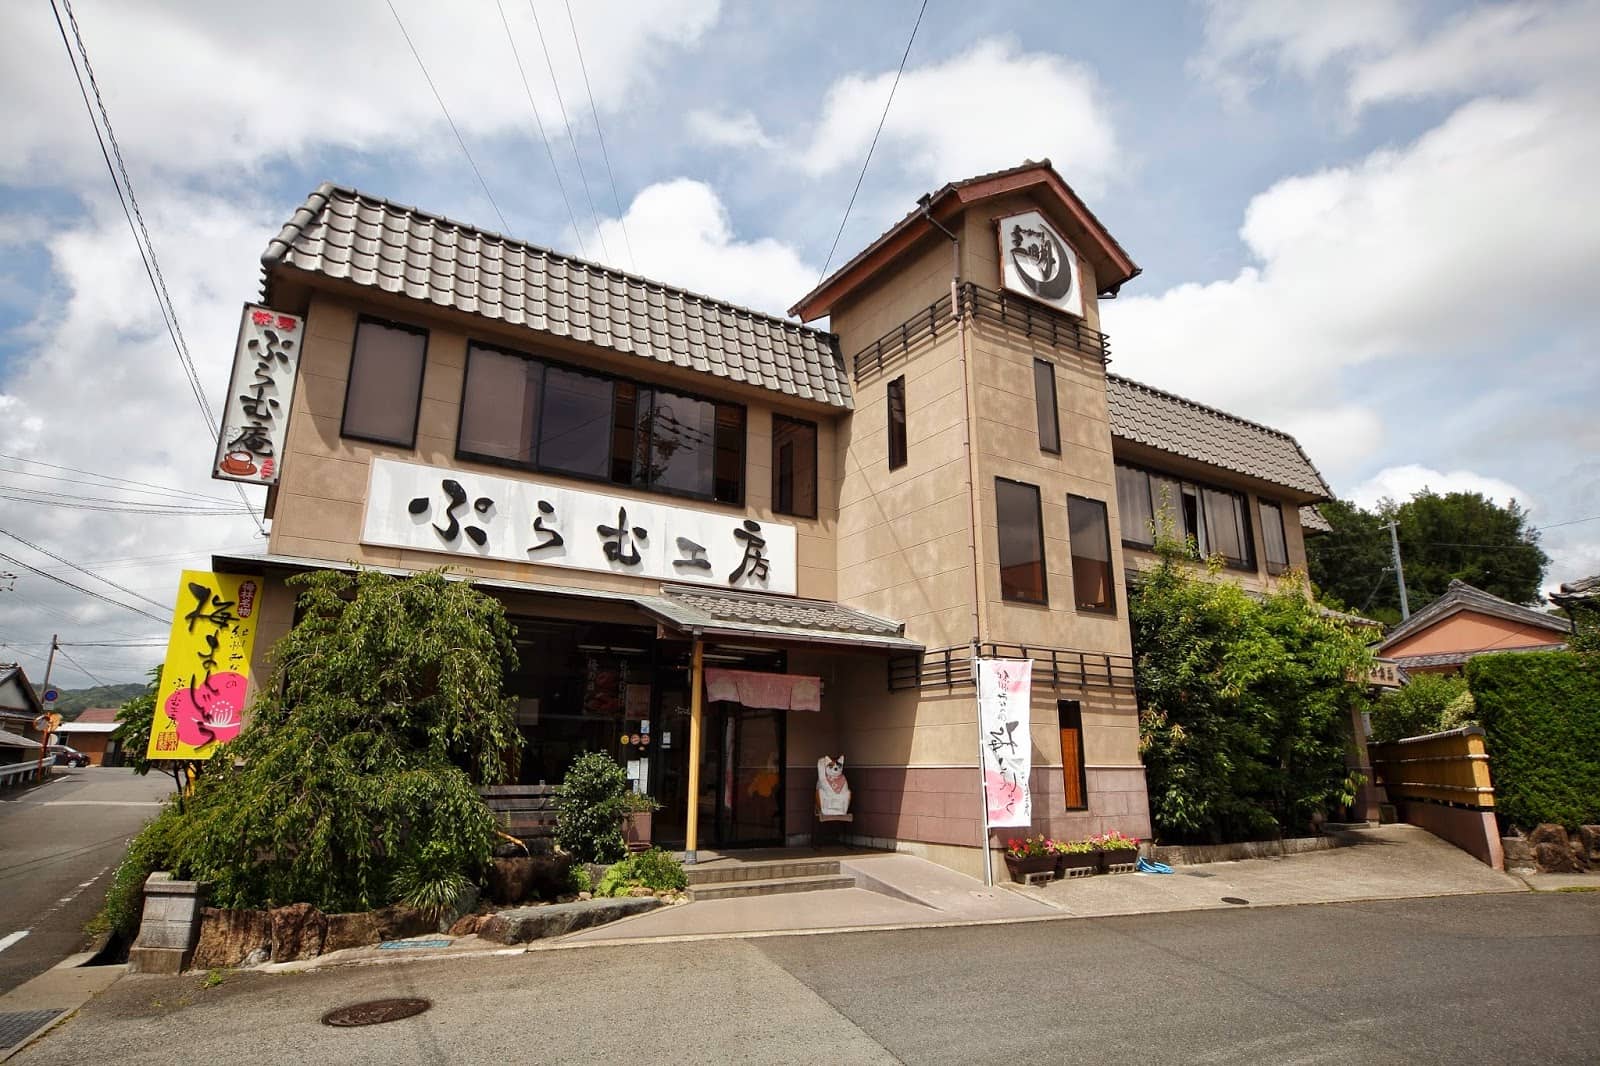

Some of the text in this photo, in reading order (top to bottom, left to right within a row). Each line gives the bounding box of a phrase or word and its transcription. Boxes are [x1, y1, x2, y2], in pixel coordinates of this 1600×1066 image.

[408, 479, 770, 583] ぷらむ工房
